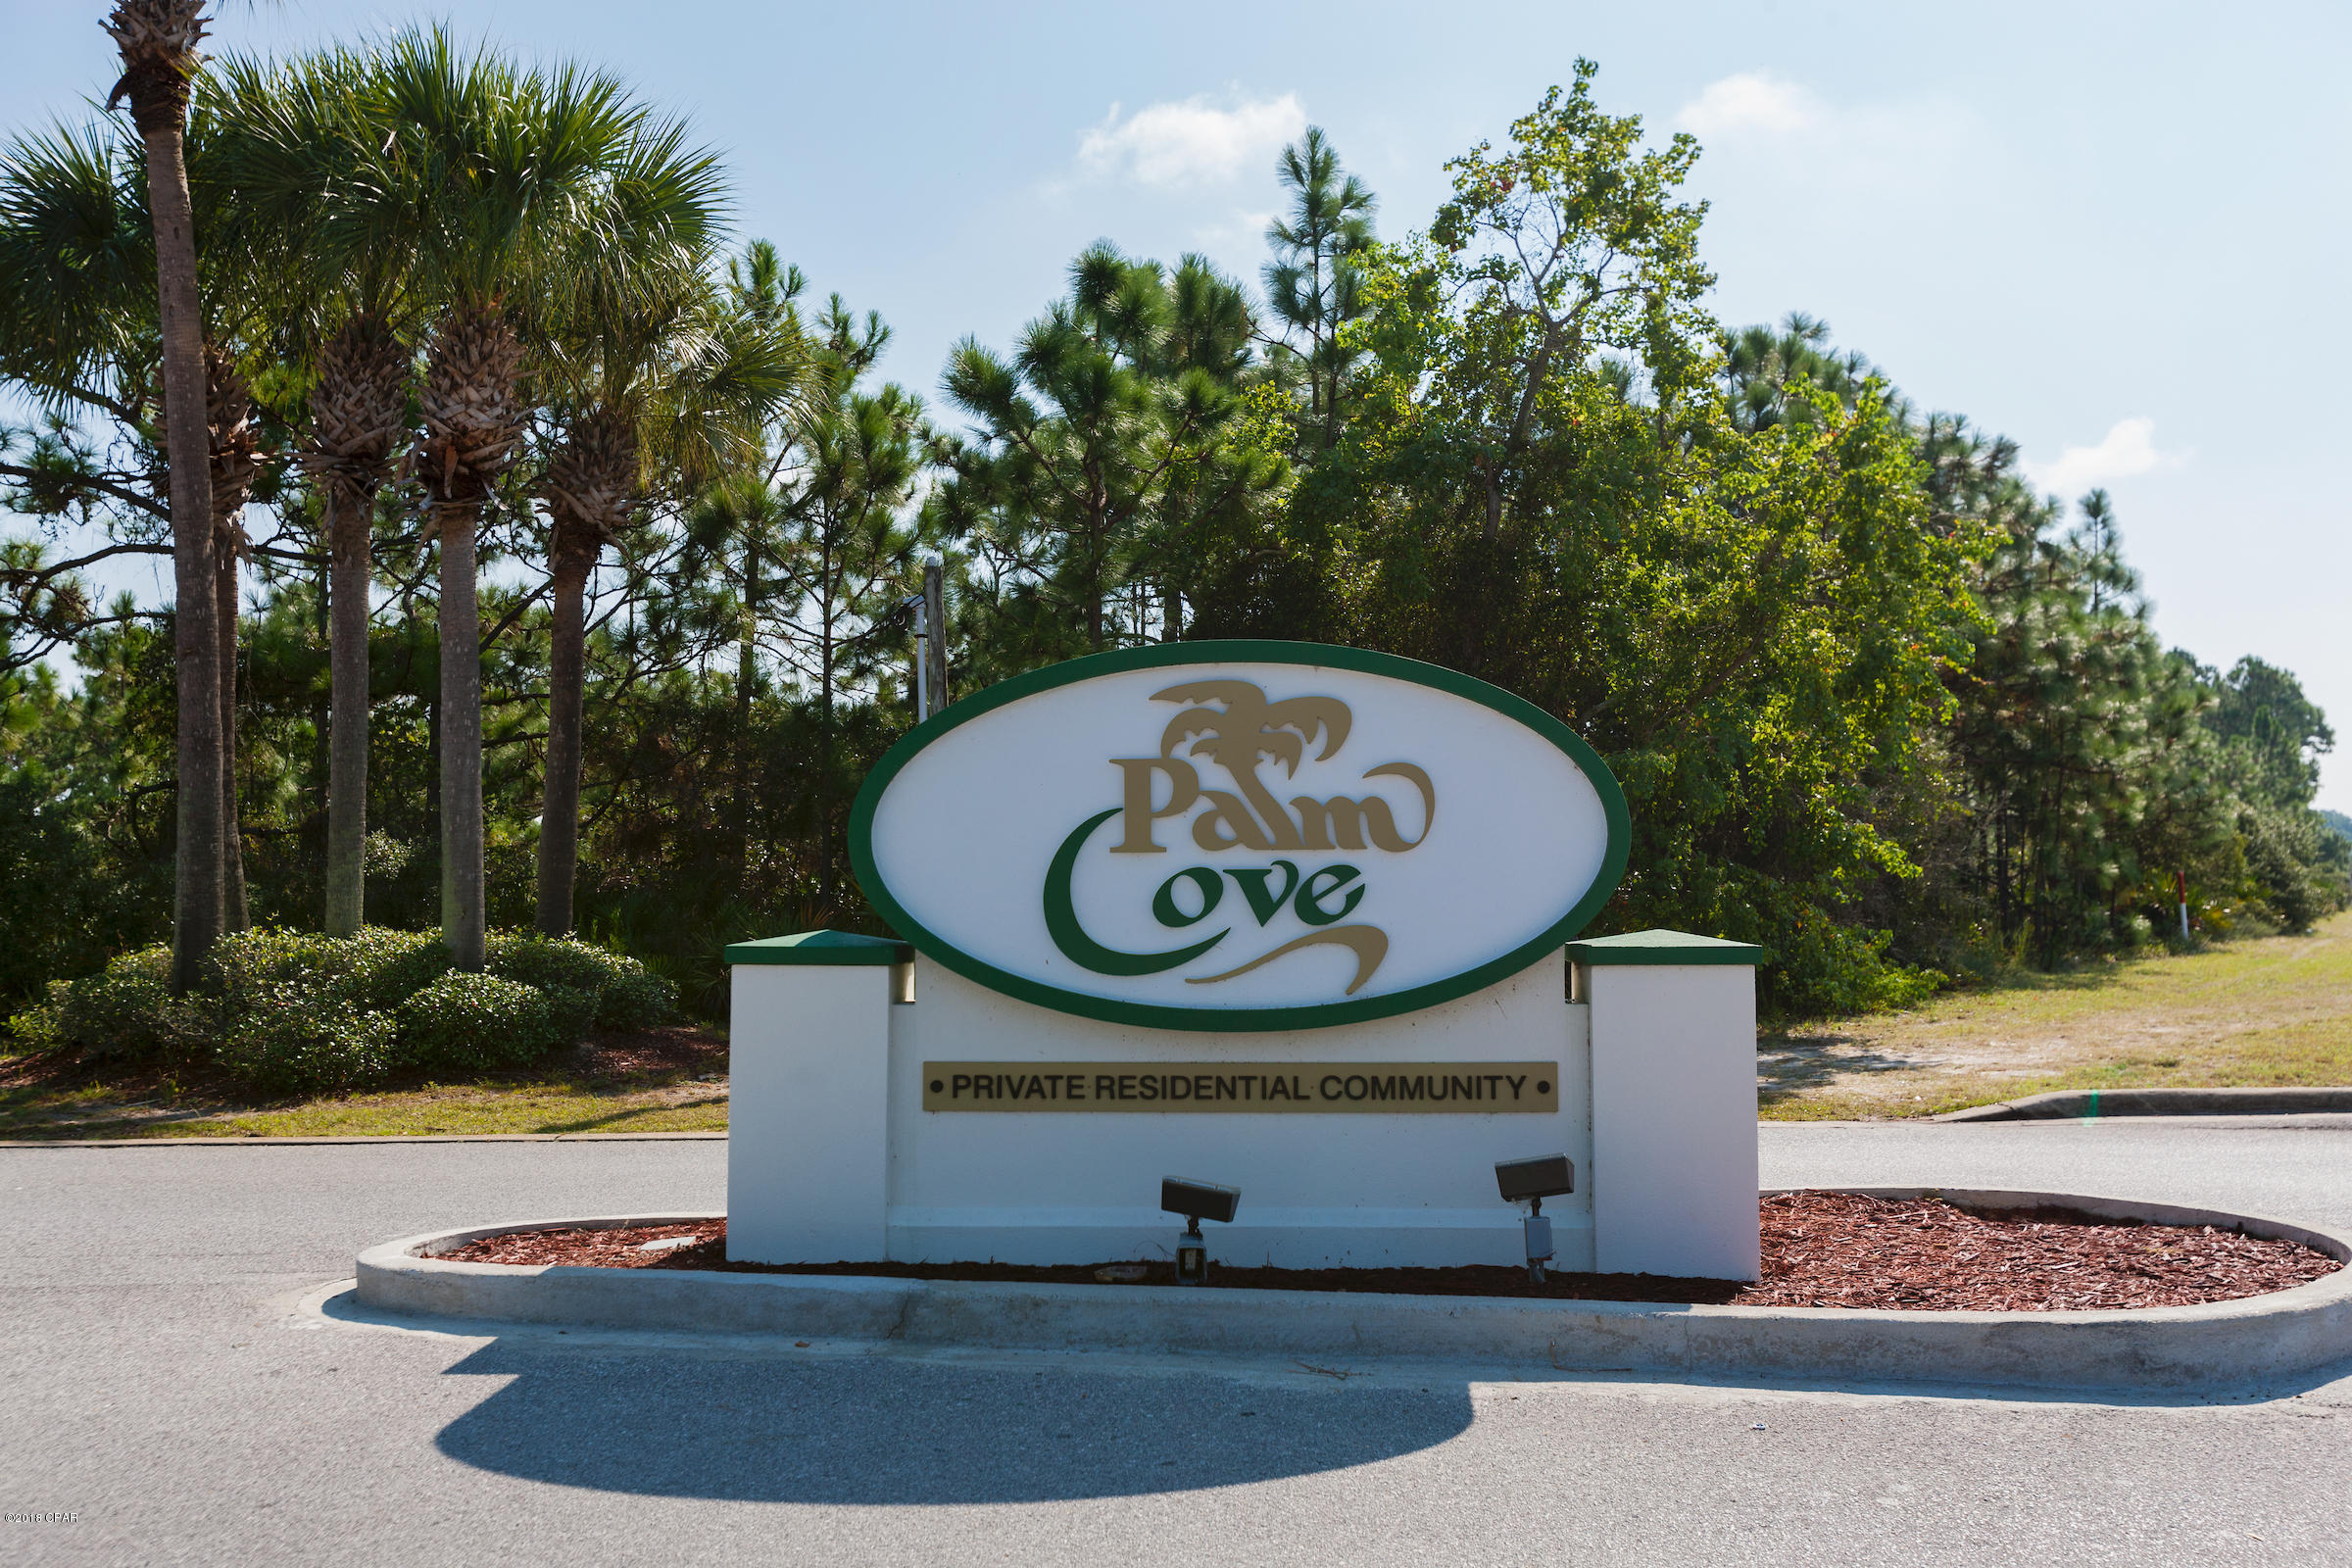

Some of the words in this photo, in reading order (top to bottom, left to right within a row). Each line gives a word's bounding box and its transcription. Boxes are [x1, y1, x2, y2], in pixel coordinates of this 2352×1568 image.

[1109, 759, 1436, 854] Palm
[1044, 808, 1366, 977] Cove
[952, 1074, 1088, 1101] PRIVATE
[1096, 1074, 1310, 1102] RESIDENTIAL
[1319, 1074, 1526, 1102] COMMUNITY
